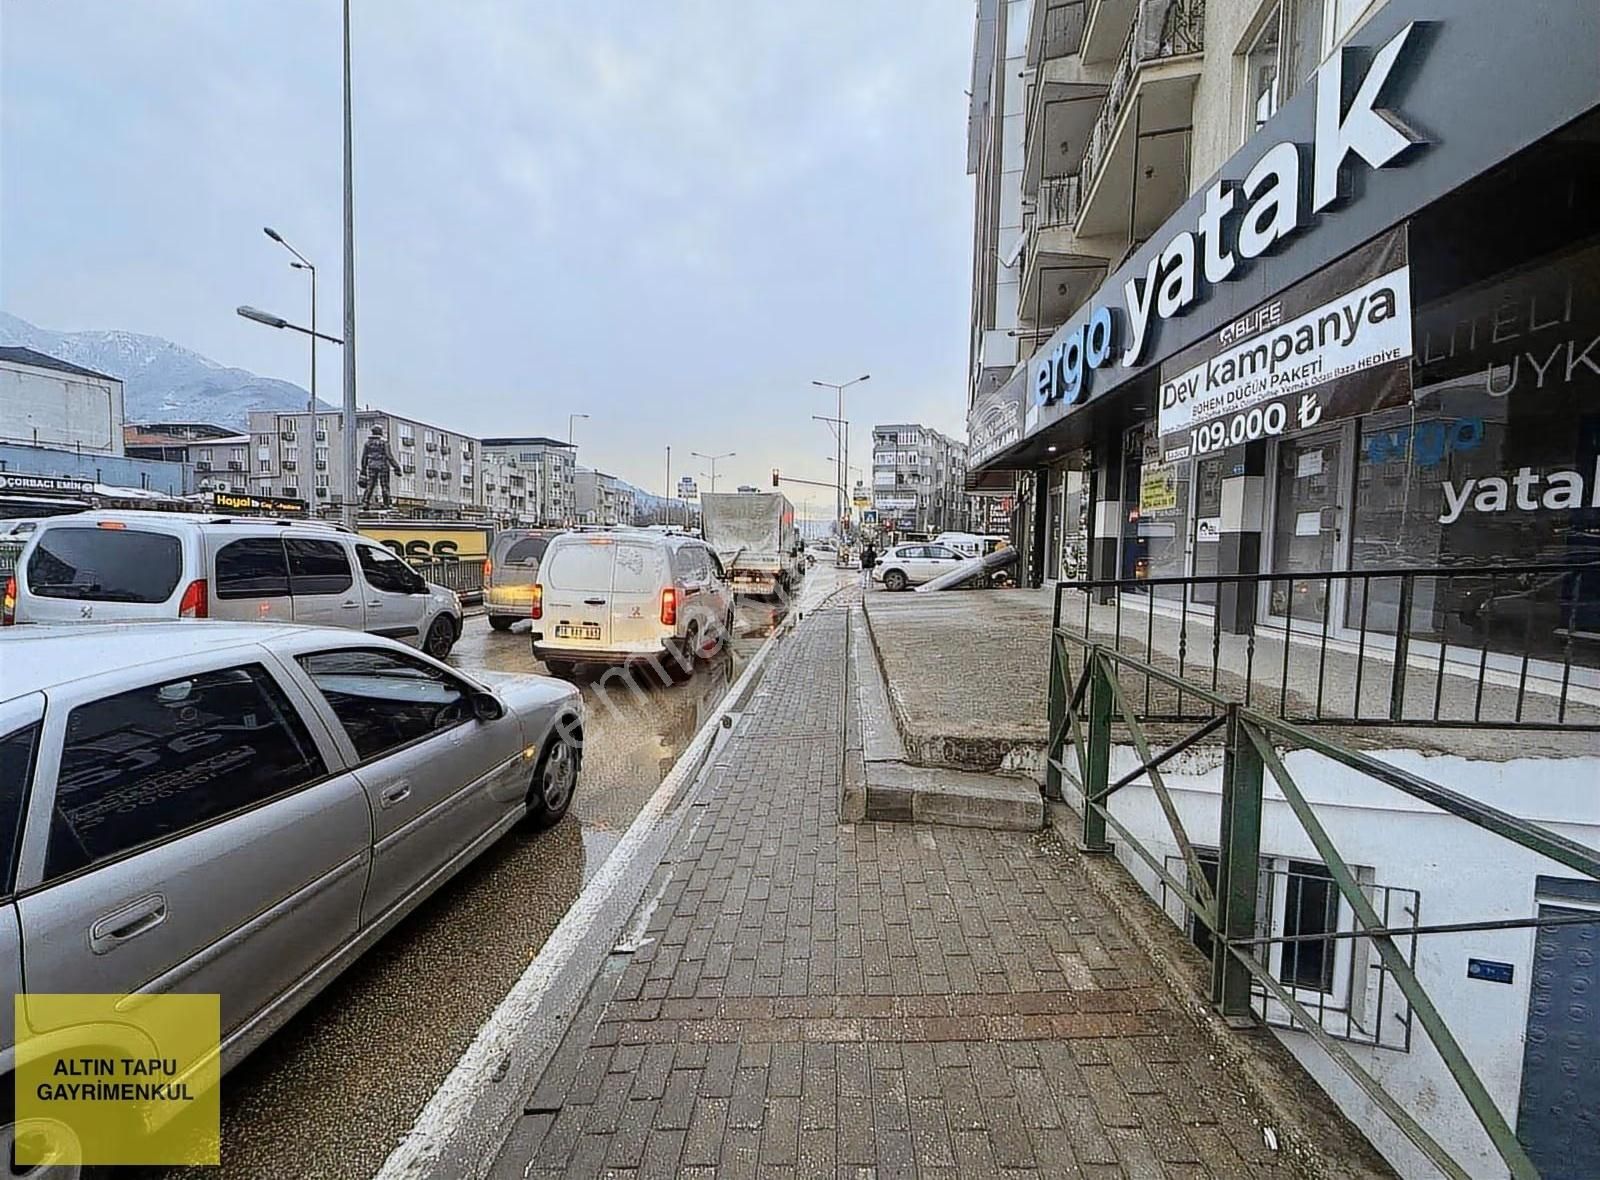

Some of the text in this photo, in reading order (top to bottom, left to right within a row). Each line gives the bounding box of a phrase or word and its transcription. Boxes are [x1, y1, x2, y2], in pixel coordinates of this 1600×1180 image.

[1035, 20, 1415, 406] ergo yatak
[1162, 287, 1397, 410] Dev kampanya
[1357, 347, 1401, 369] HEDİYE
[1227, 377, 1267, 404] DÜĞÜN
[1270, 355, 1323, 388] PAKETİ
[1189, 401, 1287, 456] 109.000
[7, 477, 54, 489] ÇORBACI
[217, 494, 250, 508] Hayal
